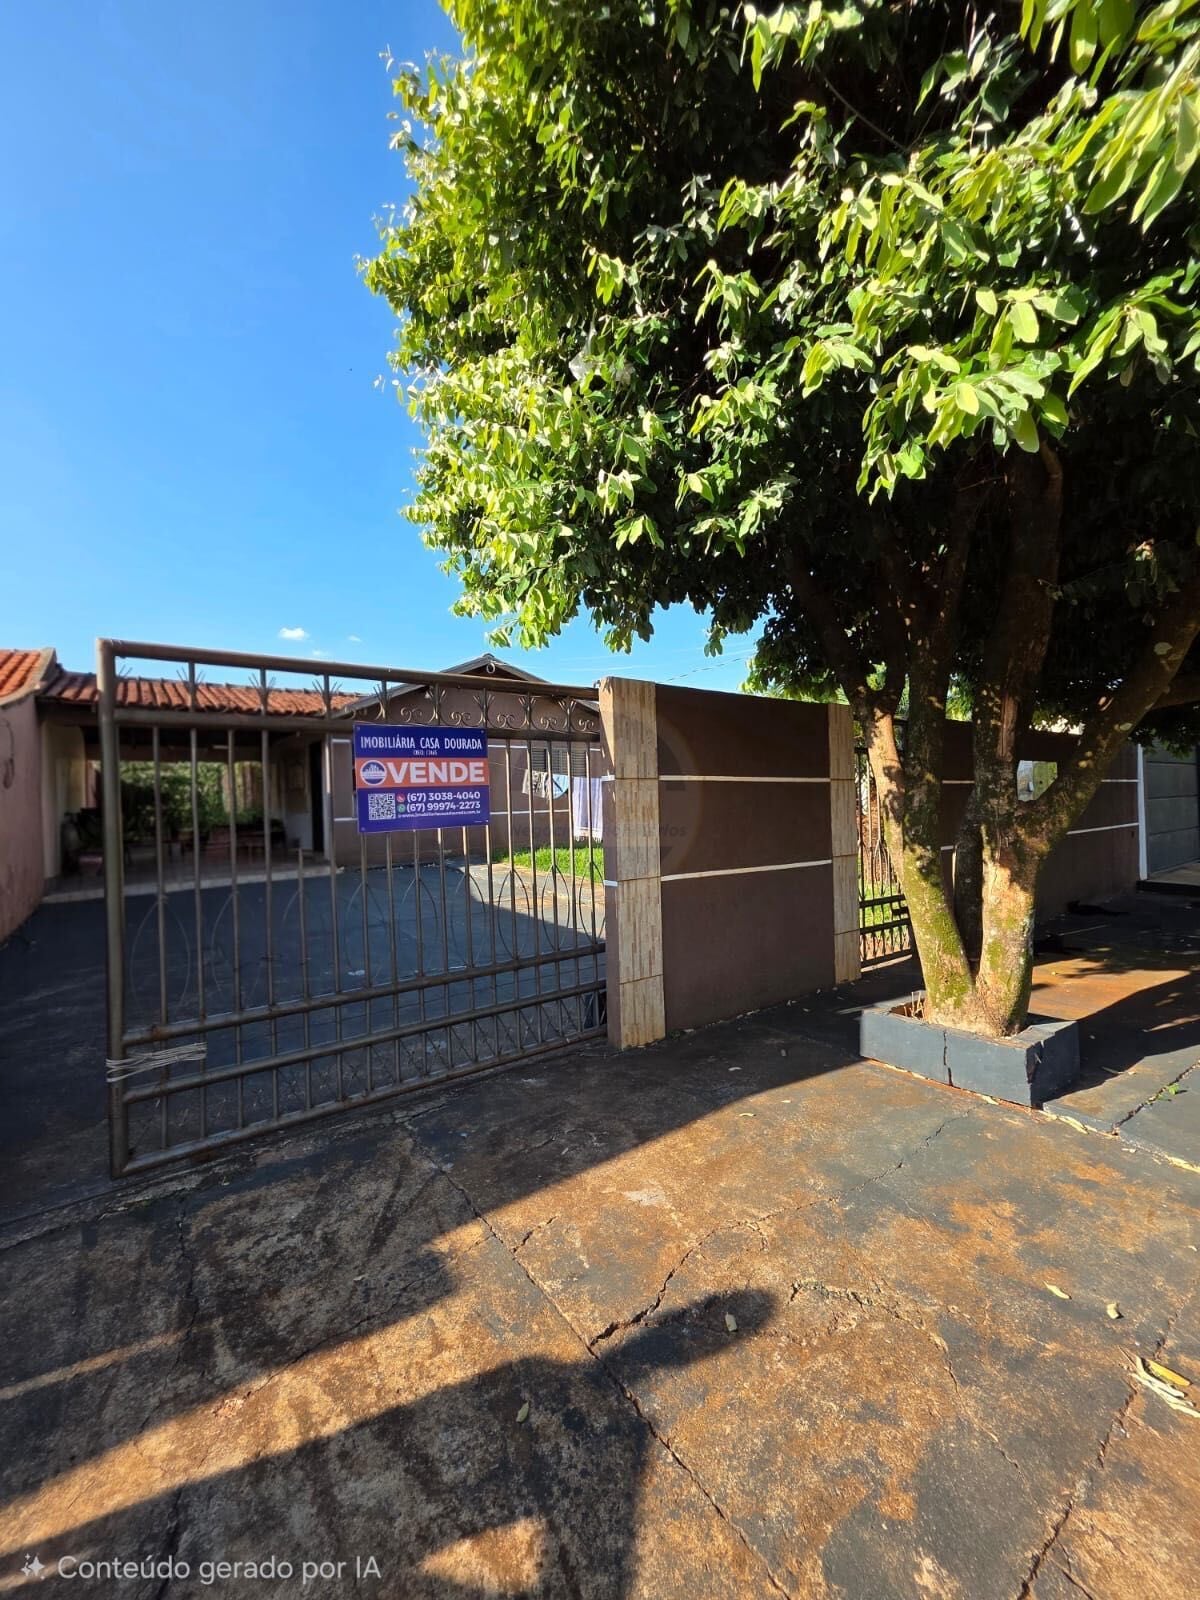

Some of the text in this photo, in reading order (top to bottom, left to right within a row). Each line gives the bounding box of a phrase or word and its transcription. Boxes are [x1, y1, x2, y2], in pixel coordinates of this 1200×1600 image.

[360, 733, 483, 750] IMOBILIÁRIA CASA DOURADA
[386, 761, 485, 784] VENDE
[407, 791, 481, 803] (67) 3038-4040
[406, 801, 481, 813] (67) 99974-2273
